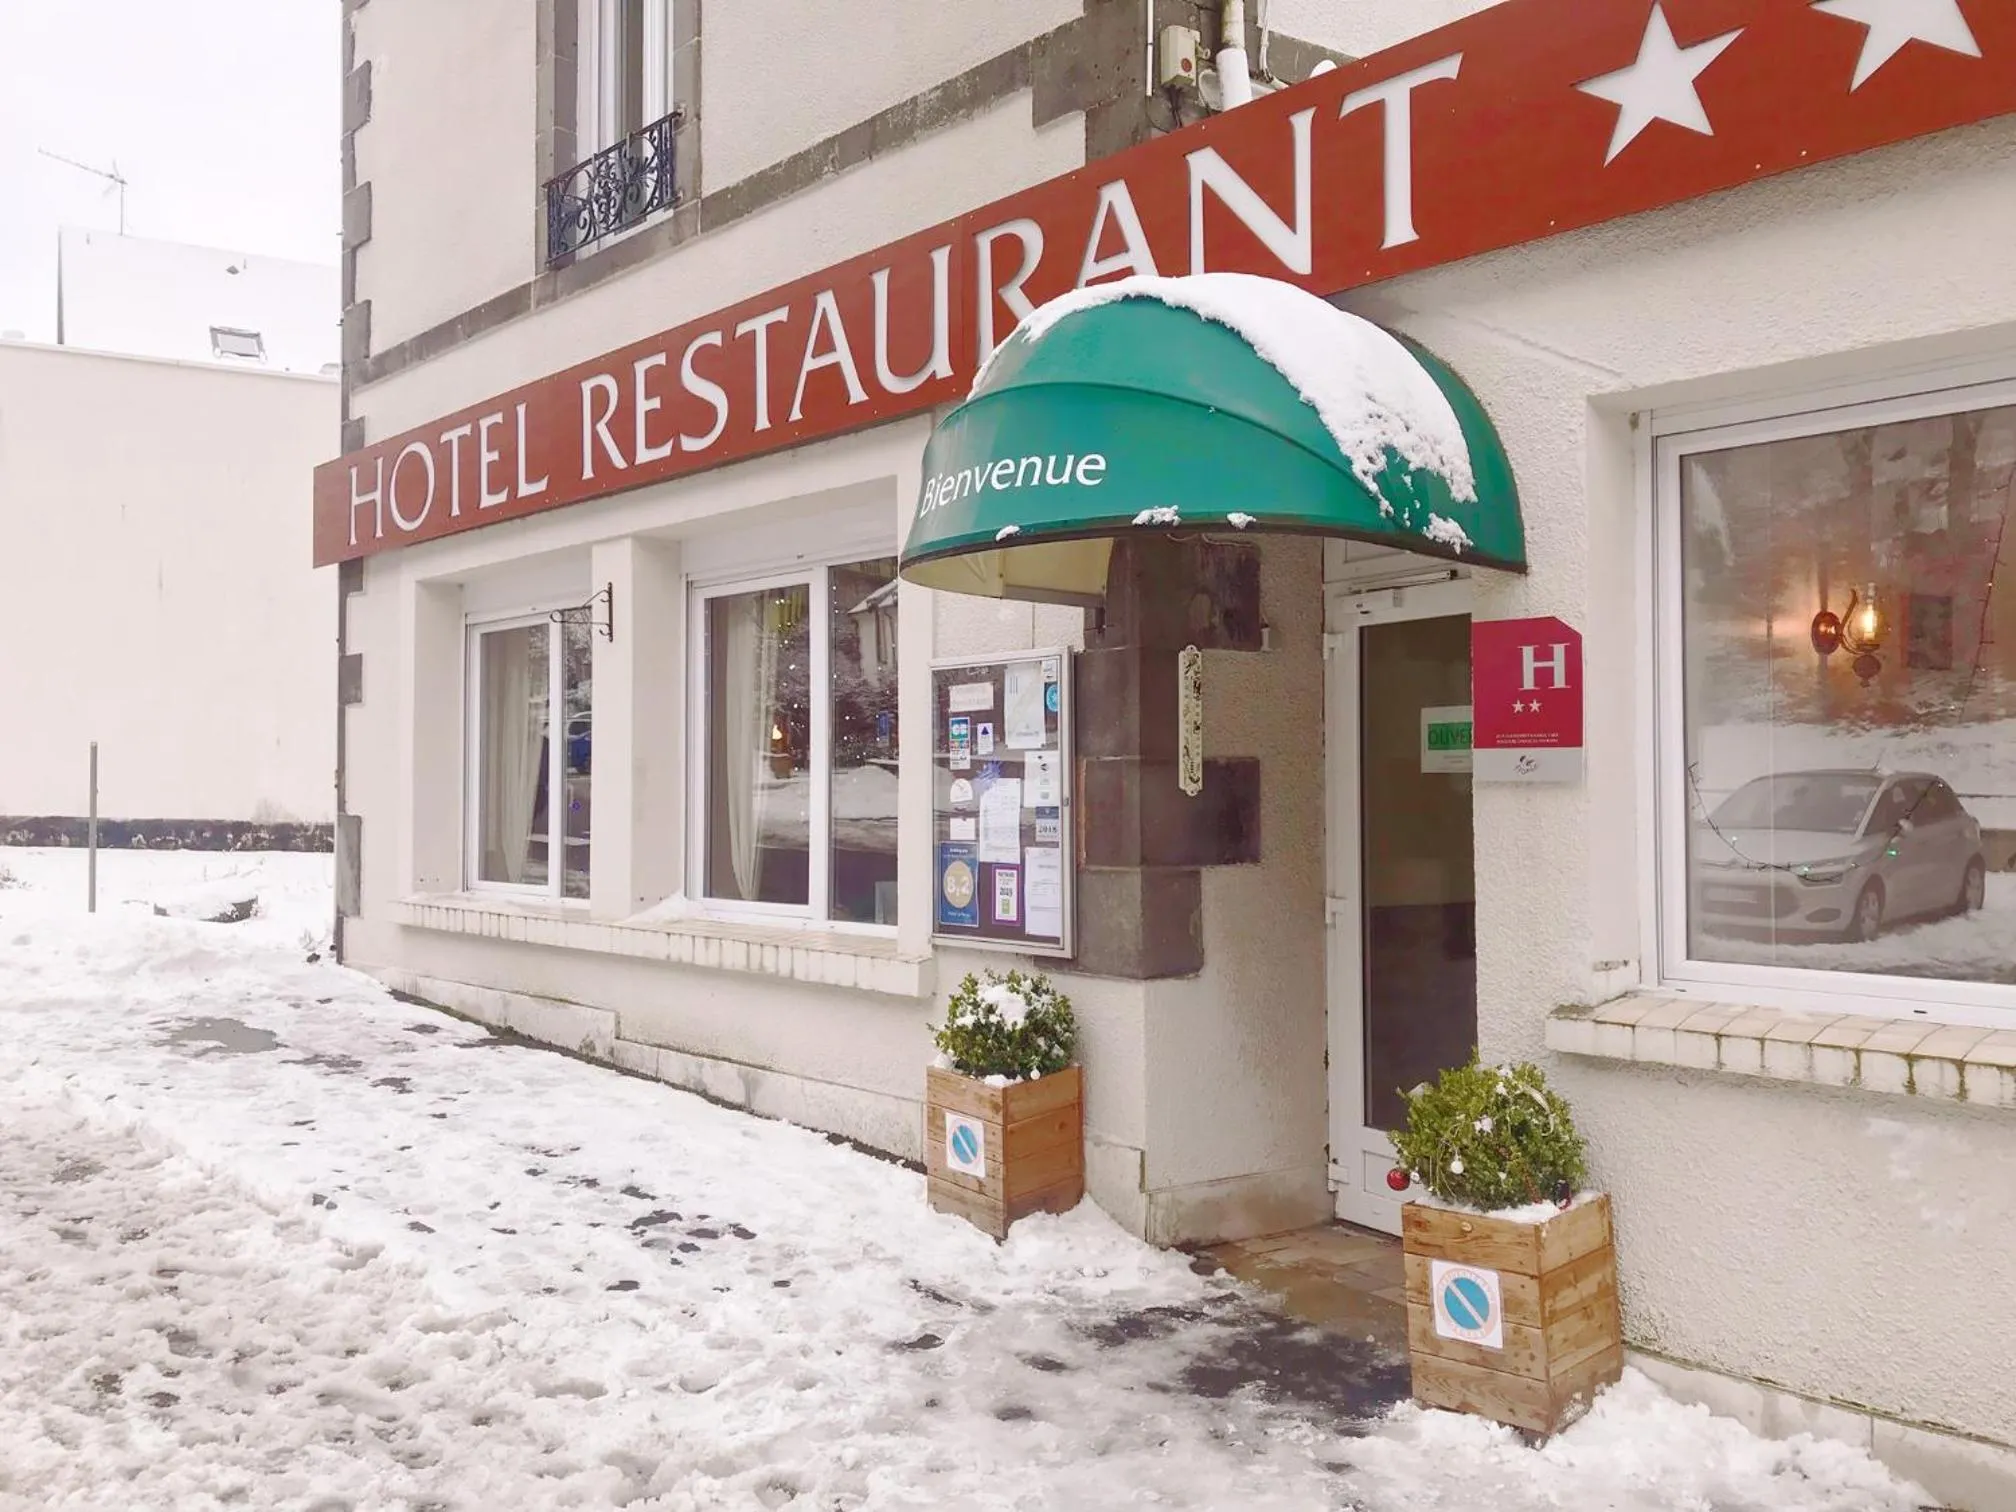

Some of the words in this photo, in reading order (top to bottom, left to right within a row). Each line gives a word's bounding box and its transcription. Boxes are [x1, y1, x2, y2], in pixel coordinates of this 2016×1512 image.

[348, 401, 550, 546] HOTEL
[580, 51, 1464, 481] RESTAURANT
[919, 452, 1107, 520] Bienvenue
[1517, 642, 1572, 691] H
